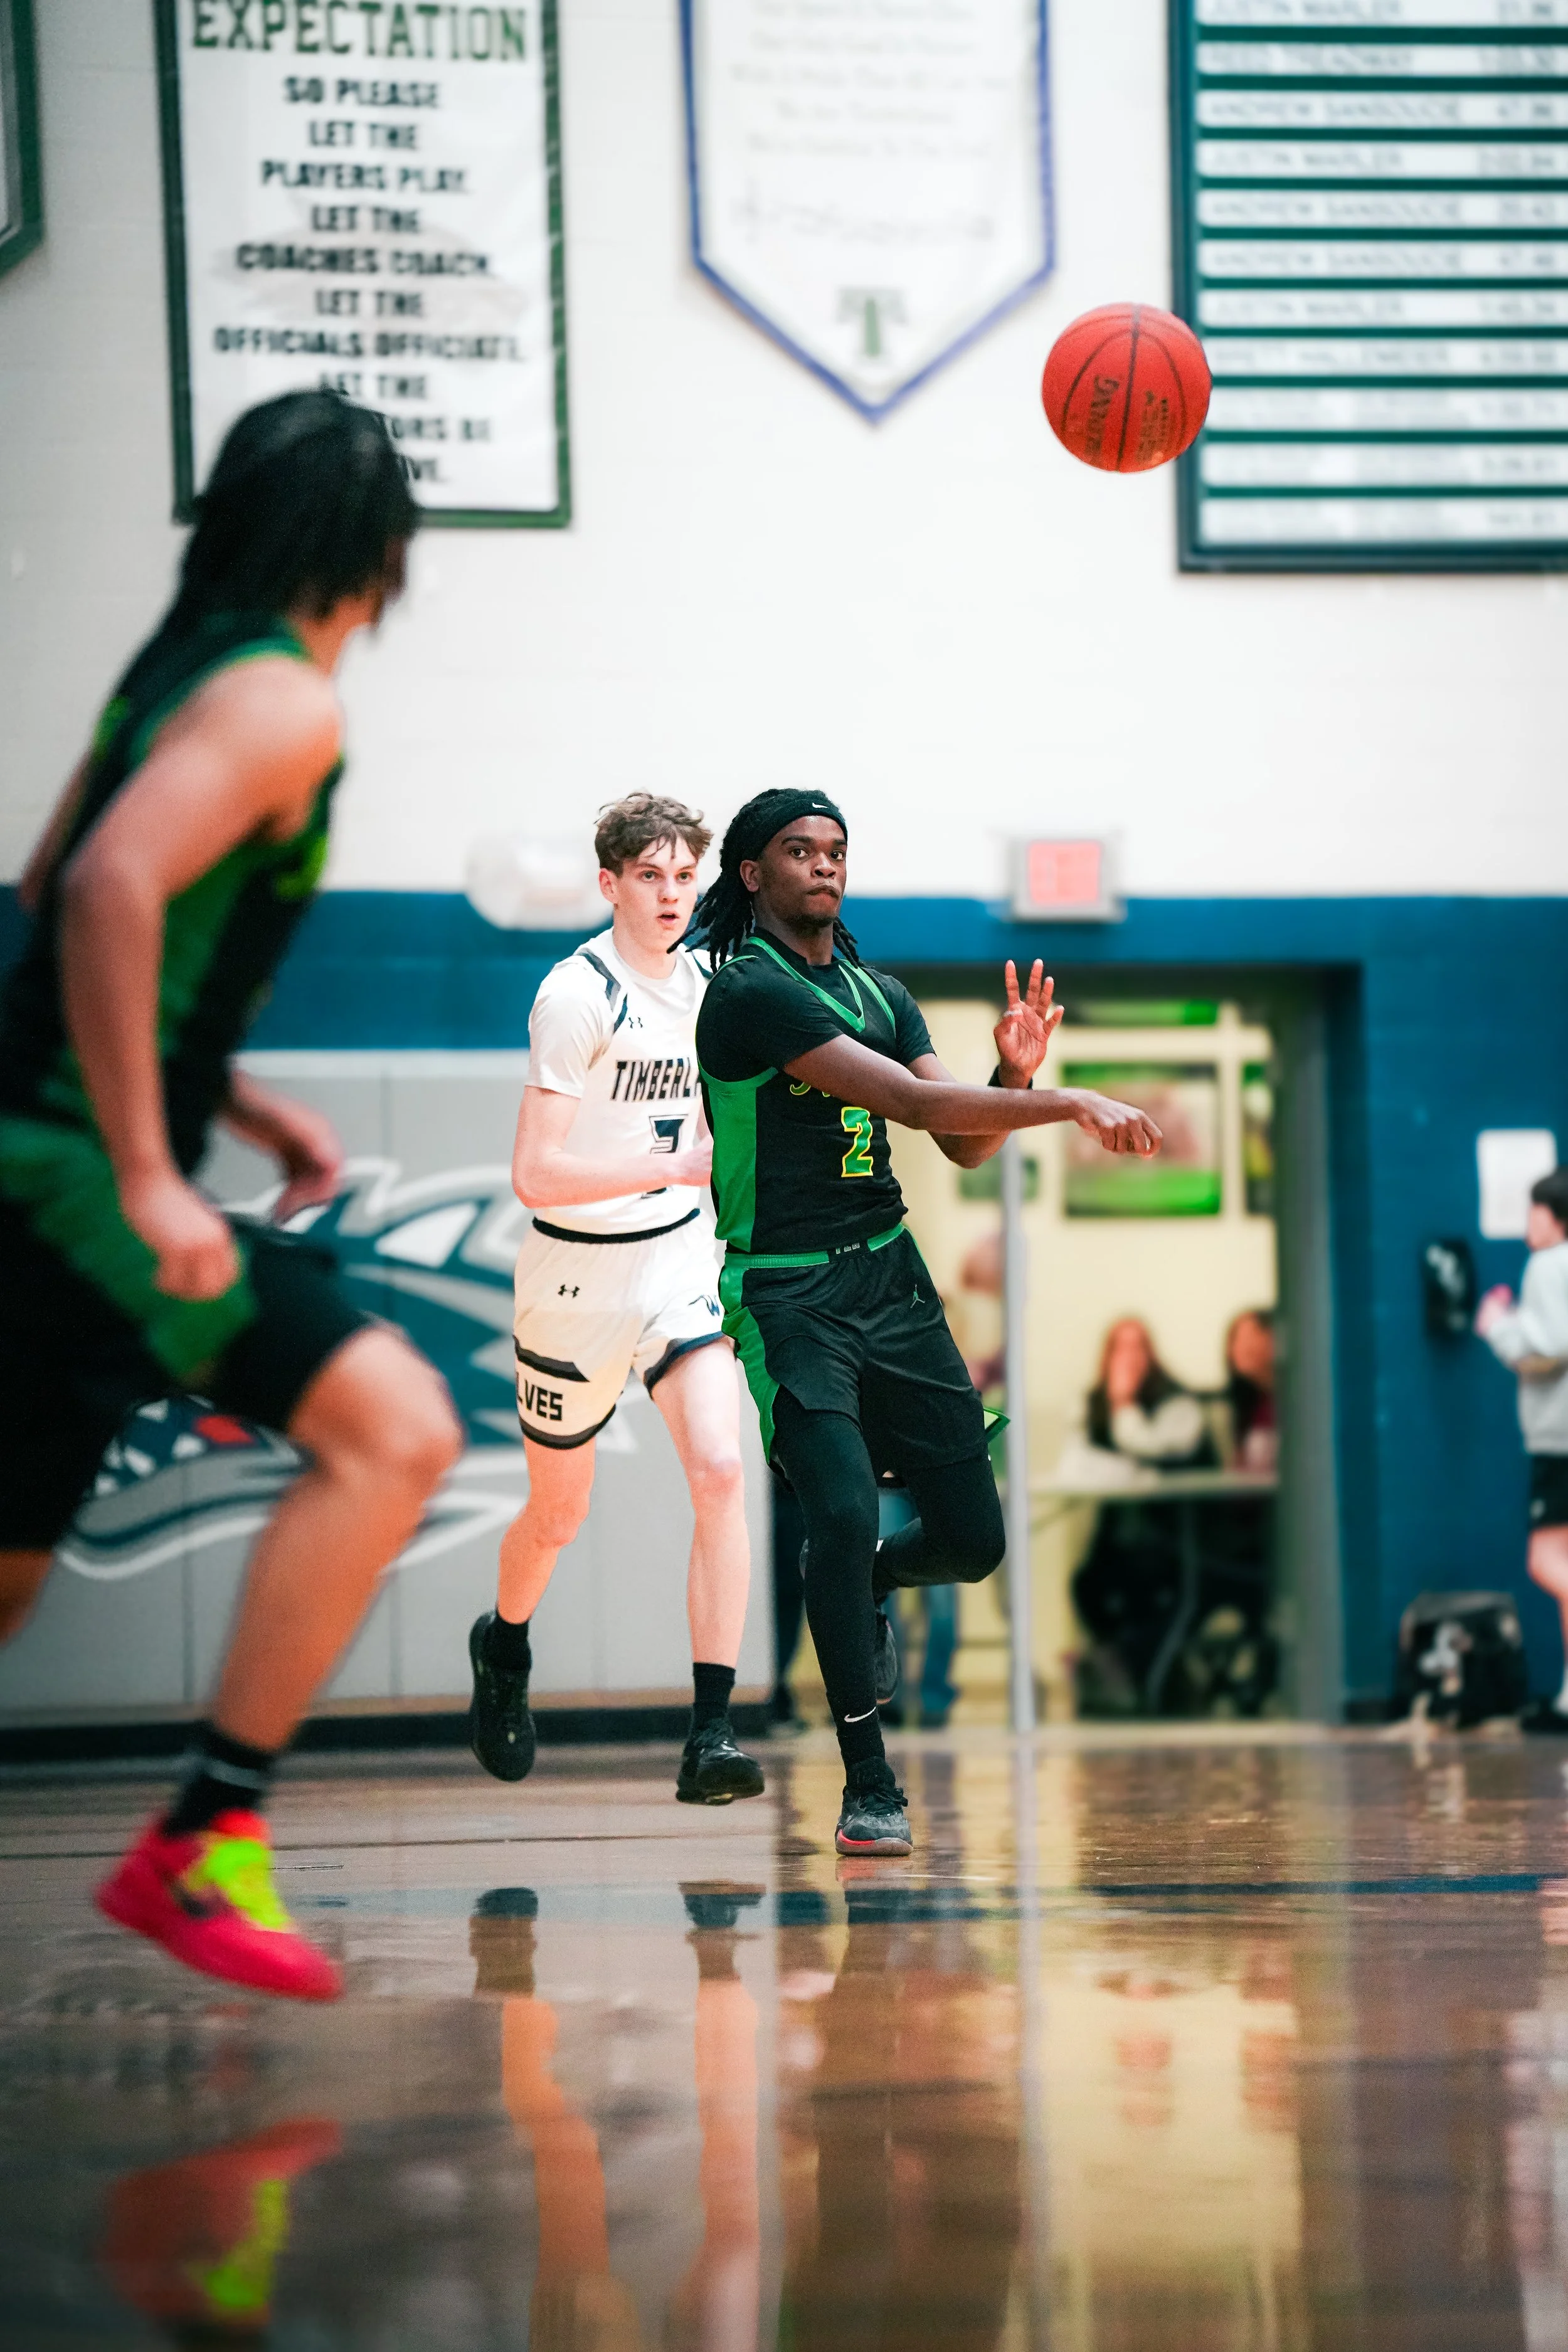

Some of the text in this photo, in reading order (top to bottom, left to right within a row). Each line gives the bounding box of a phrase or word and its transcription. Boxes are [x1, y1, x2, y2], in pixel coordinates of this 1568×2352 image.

[191, 0, 526, 61] EXPECTATION
[283, 76, 441, 108] SO PLEASE
[308, 119, 418, 150] LET THE
[261, 159, 386, 191] PLAYERS
[311, 204, 420, 233] LET THE
[236, 243, 379, 274] COACHES
[315, 289, 423, 316] LET THE
[214, 327, 363, 358] OFFICIALS
[378, 374, 426, 400] THE
[841, 1106, 874, 1178] 2
